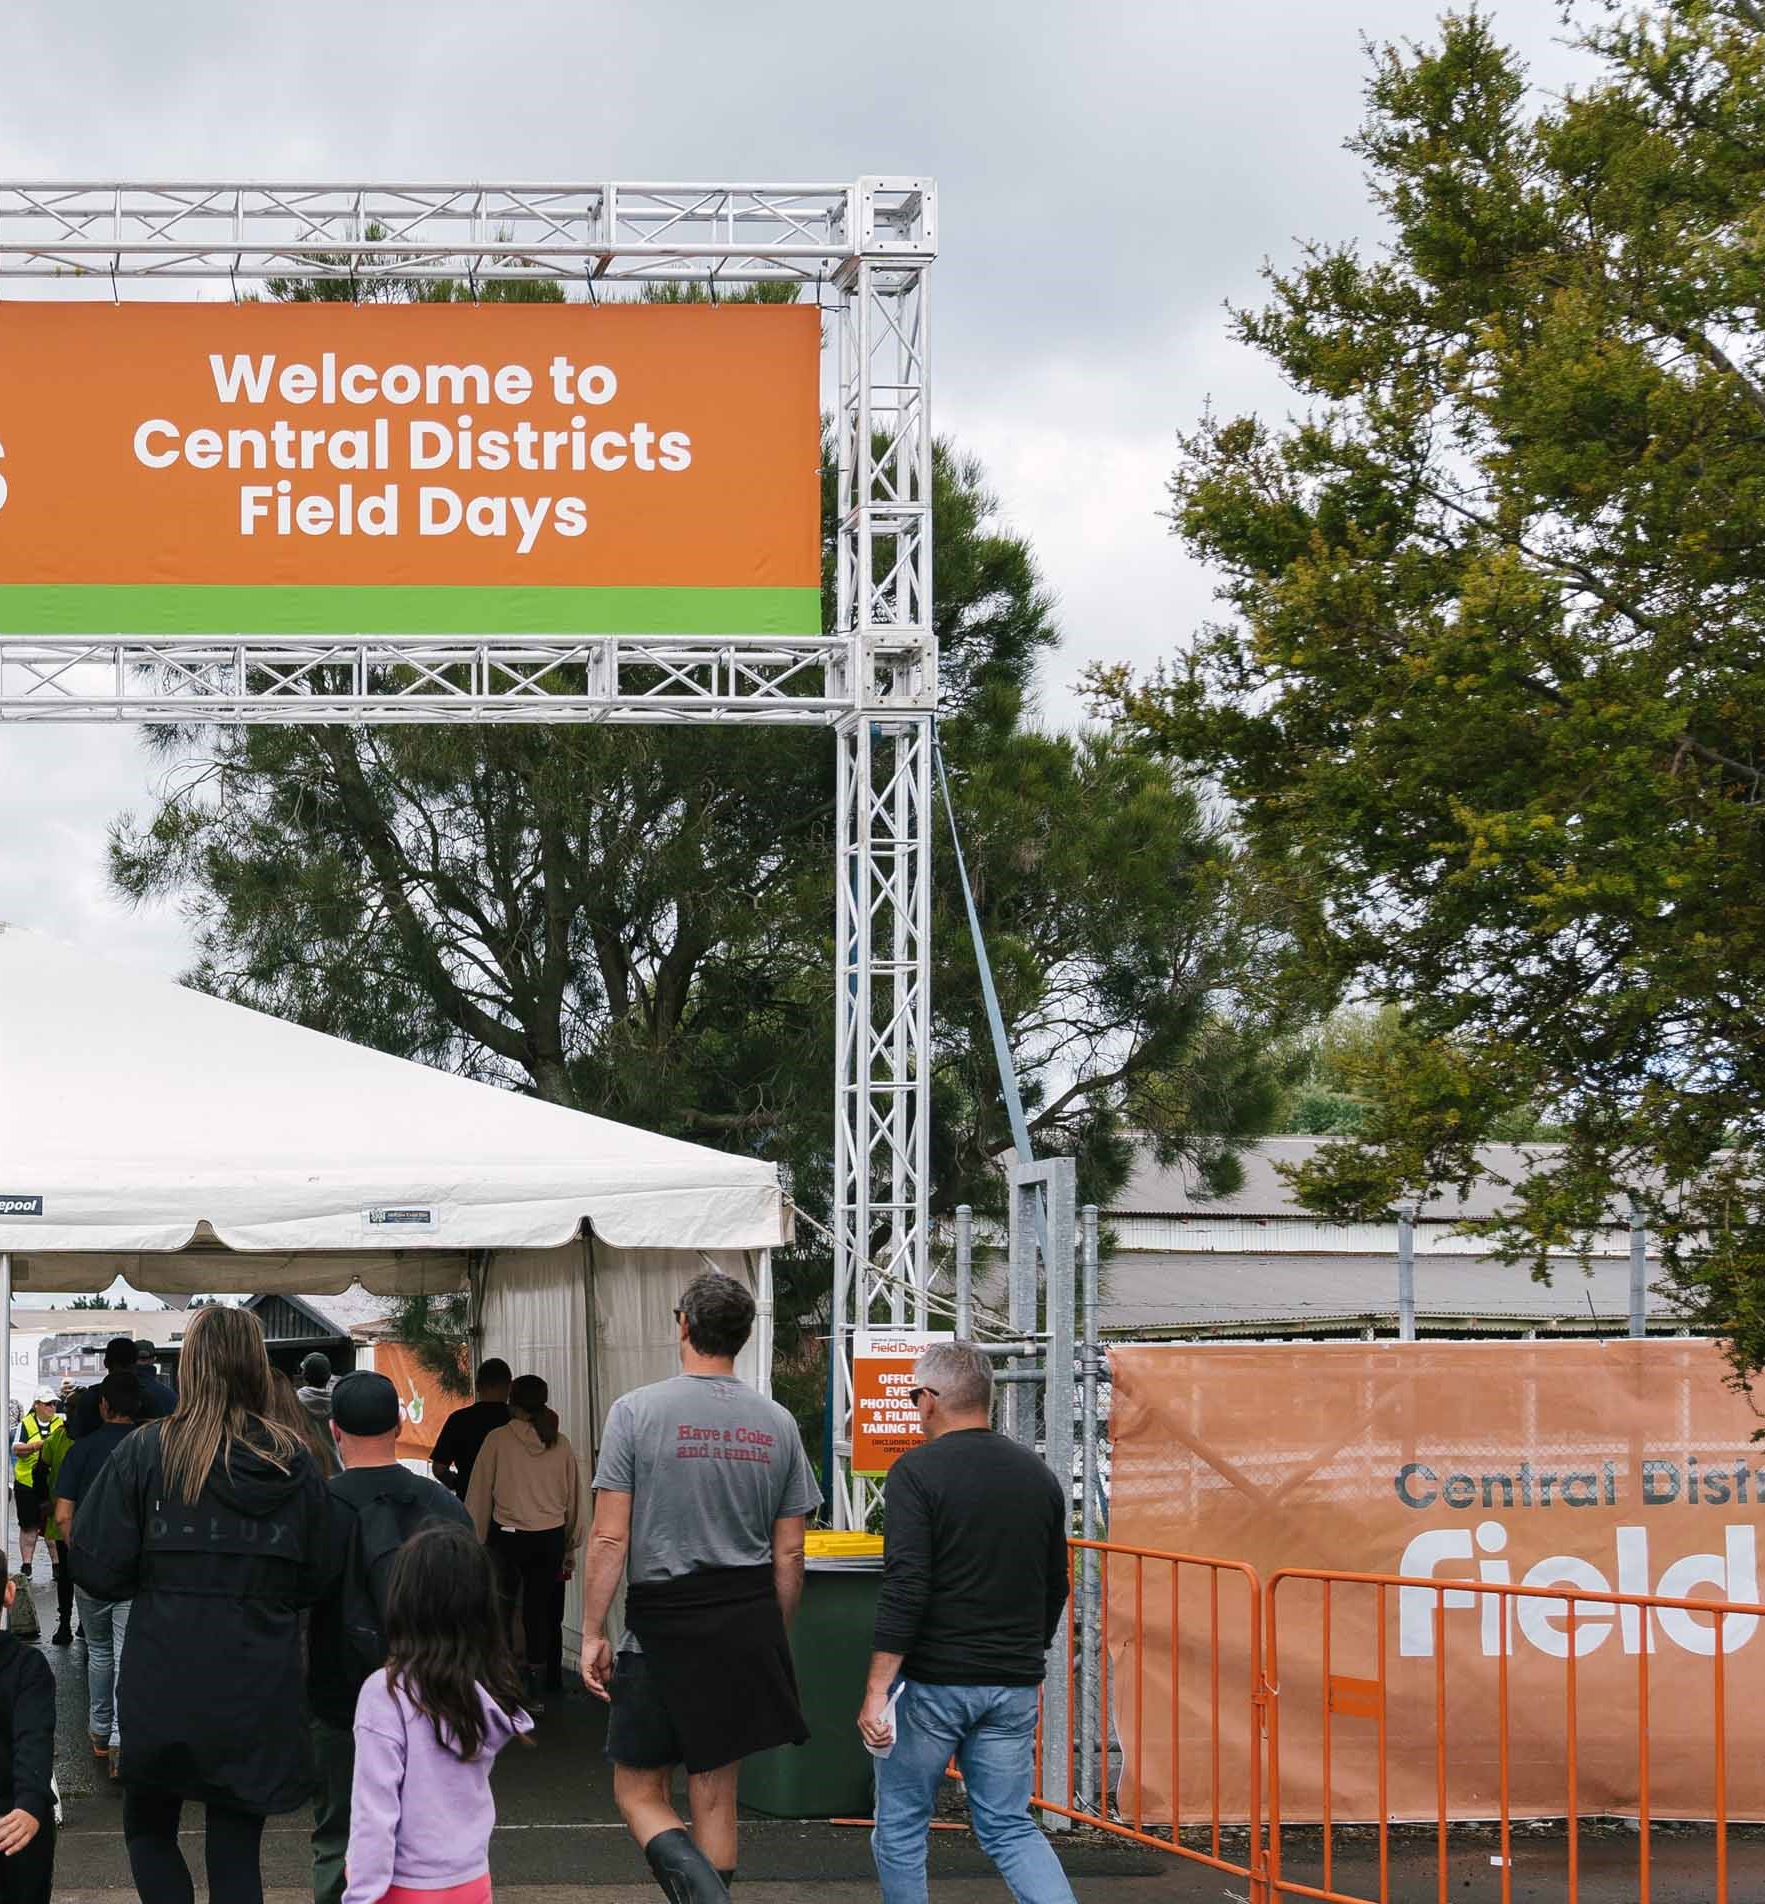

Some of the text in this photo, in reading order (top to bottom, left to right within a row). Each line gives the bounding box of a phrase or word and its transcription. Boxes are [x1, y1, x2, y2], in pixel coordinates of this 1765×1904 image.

[209, 352, 618, 405] Welcome to
[133, 414, 692, 472] Central Districts
[240, 480, 588, 554] Field Days
[871, 1342, 897, 1353] Field
[878, 1373, 919, 1384] OFFICI
[885, 1386, 913, 1397] EVE
[859, 1399, 918, 1409] PHOTOGR
[873, 1410, 922, 1421] & FILMI
[677, 1423, 775, 1447] Have a Coke
[861, 1423, 907, 1434] TAKING
[676, 1442, 710, 1458] and
[714, 1447, 723, 1459] a
[1394, 1460, 1617, 1509] Central
[1398, 1520, 1760, 1658] Field
